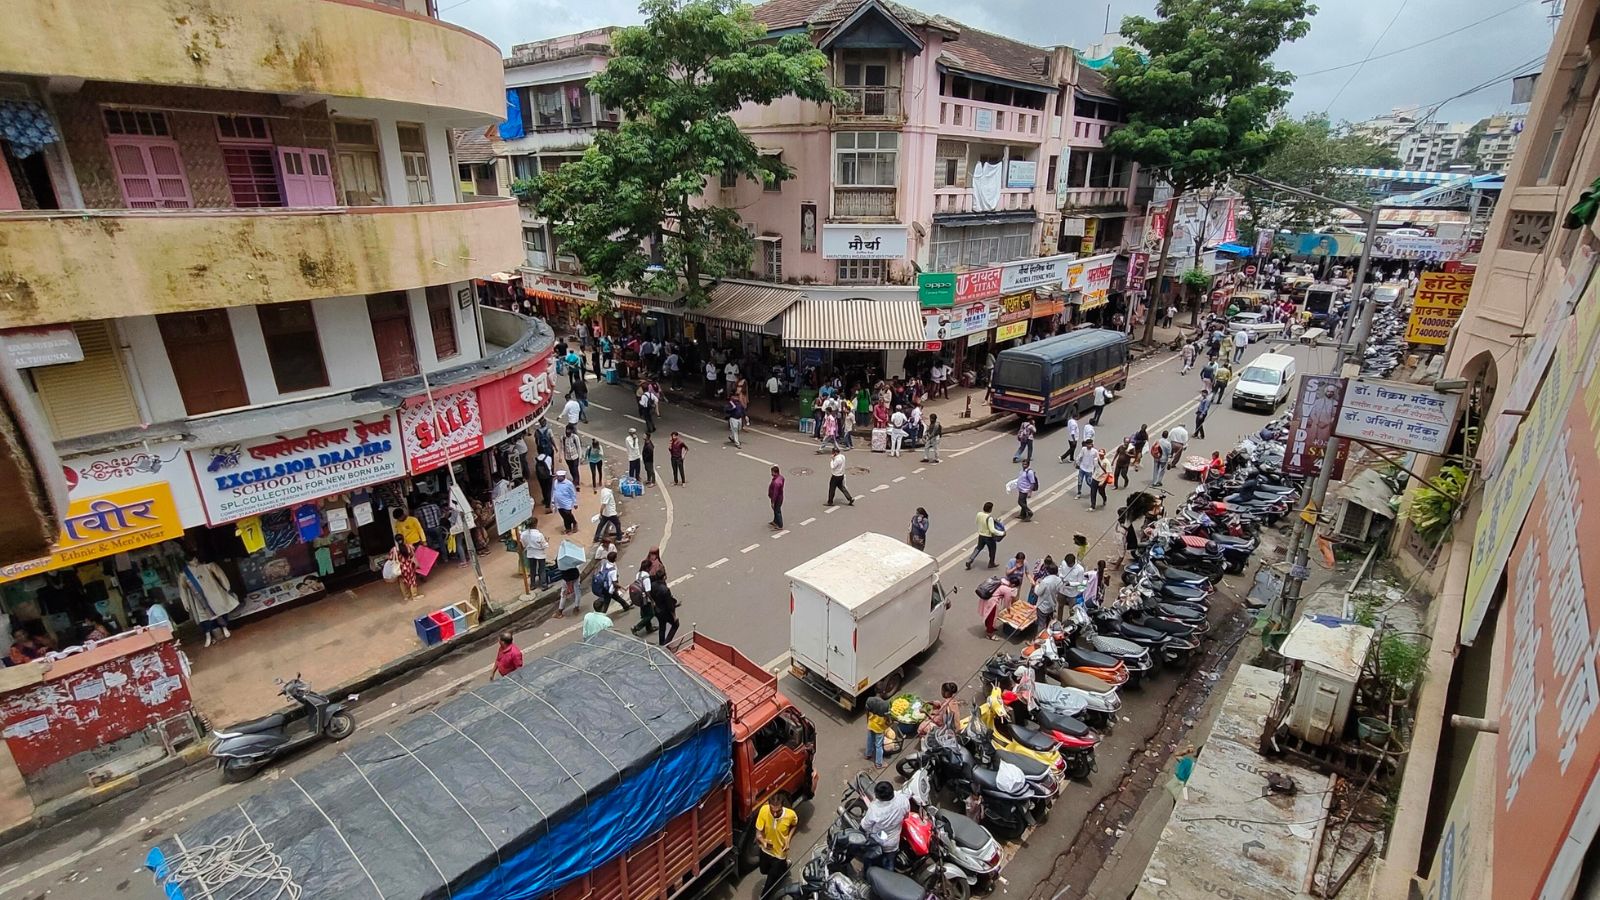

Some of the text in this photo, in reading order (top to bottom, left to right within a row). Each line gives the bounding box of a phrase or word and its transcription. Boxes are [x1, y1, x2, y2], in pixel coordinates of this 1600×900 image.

[848, 235, 882, 251] मौर्या
[970, 268, 1001, 284] टायटन
[973, 279, 998, 292] TITAN
[1419, 291, 1468, 307] मनह
[1354, 385, 1371, 396] डॉ.
[1377, 387, 1408, 401] विक्रम
[415, 397, 473, 449] SALE
[1289, 379, 1319, 467] SUVIDHA
[1345, 411, 1360, 422] डॉ.
[506, 419, 524, 434] MULTI
[1308, 446, 1345, 460] SAE
[215, 457, 316, 491] EXCELSIOR
[318, 440, 393, 467] DRAPERS
[232, 475, 301, 498] SCHOOL
[305, 454, 384, 480] UNIFORMS
[305, 479, 324, 490] FOR
[326, 474, 346, 485] NEW
[348, 467, 372, 479] BORN
[373, 462, 396, 473] BABY
[64, 500, 159, 539] ावीर
[60, 547, 96, 562] Ethnic
[99, 543, 110, 552] &
[112, 533, 141, 551] Men's
[140, 530, 165, 543] Wear
